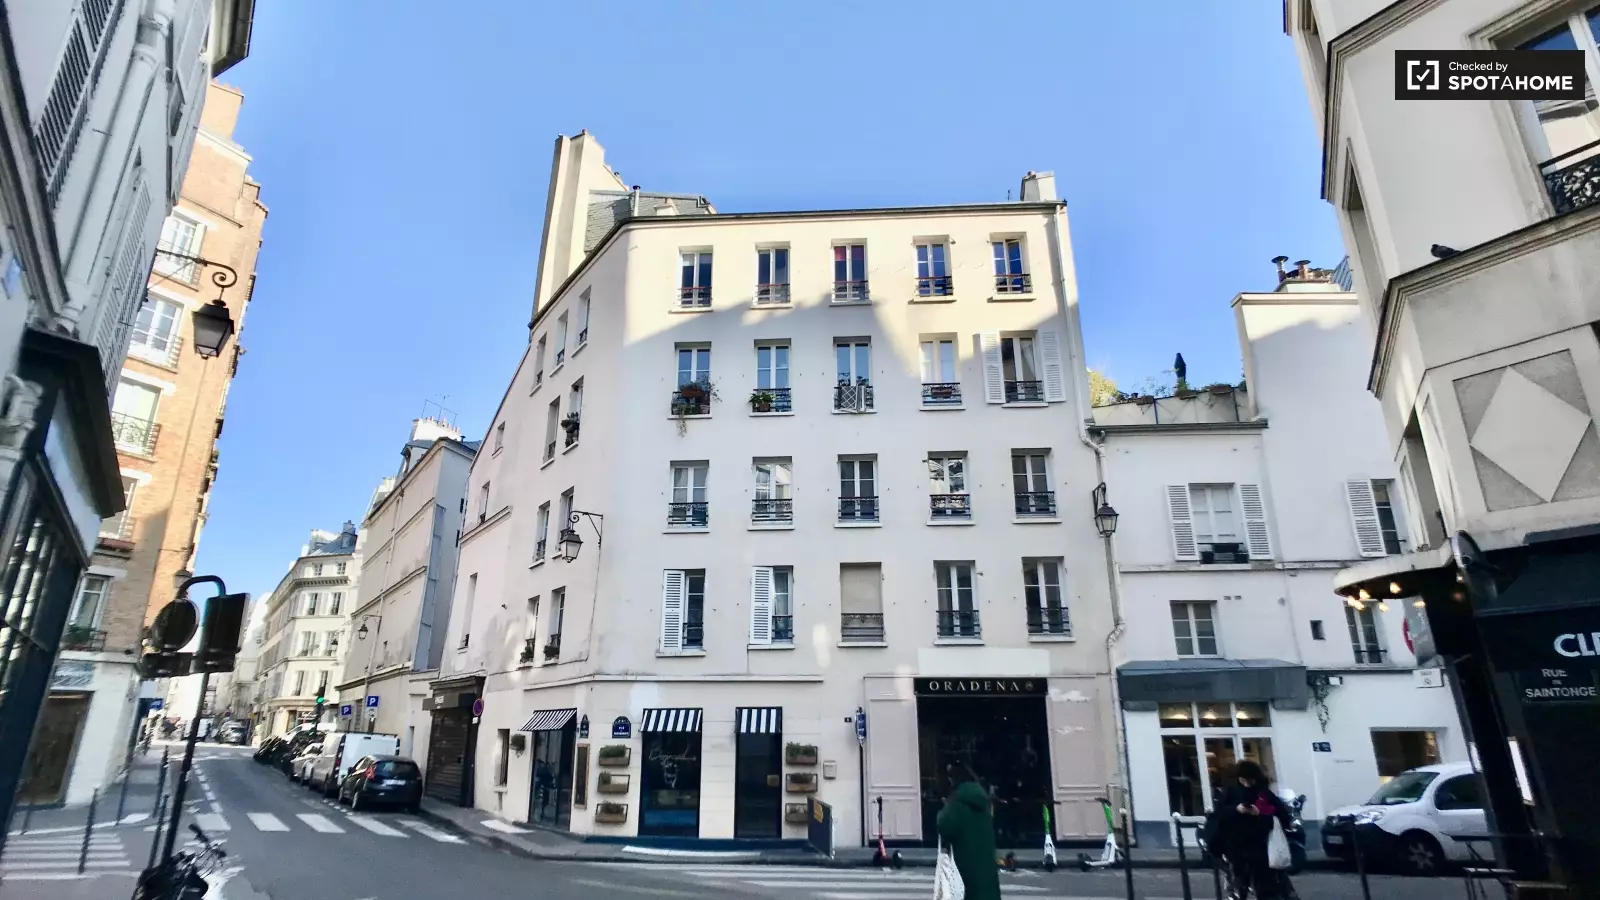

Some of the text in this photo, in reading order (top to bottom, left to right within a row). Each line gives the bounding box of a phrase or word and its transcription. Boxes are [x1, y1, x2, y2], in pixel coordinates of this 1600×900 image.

[1541, 668, 1567, 677] RUE
[929, 680, 1020, 692] ORADENA
[1525, 686, 1597, 698] SAINTONGE
